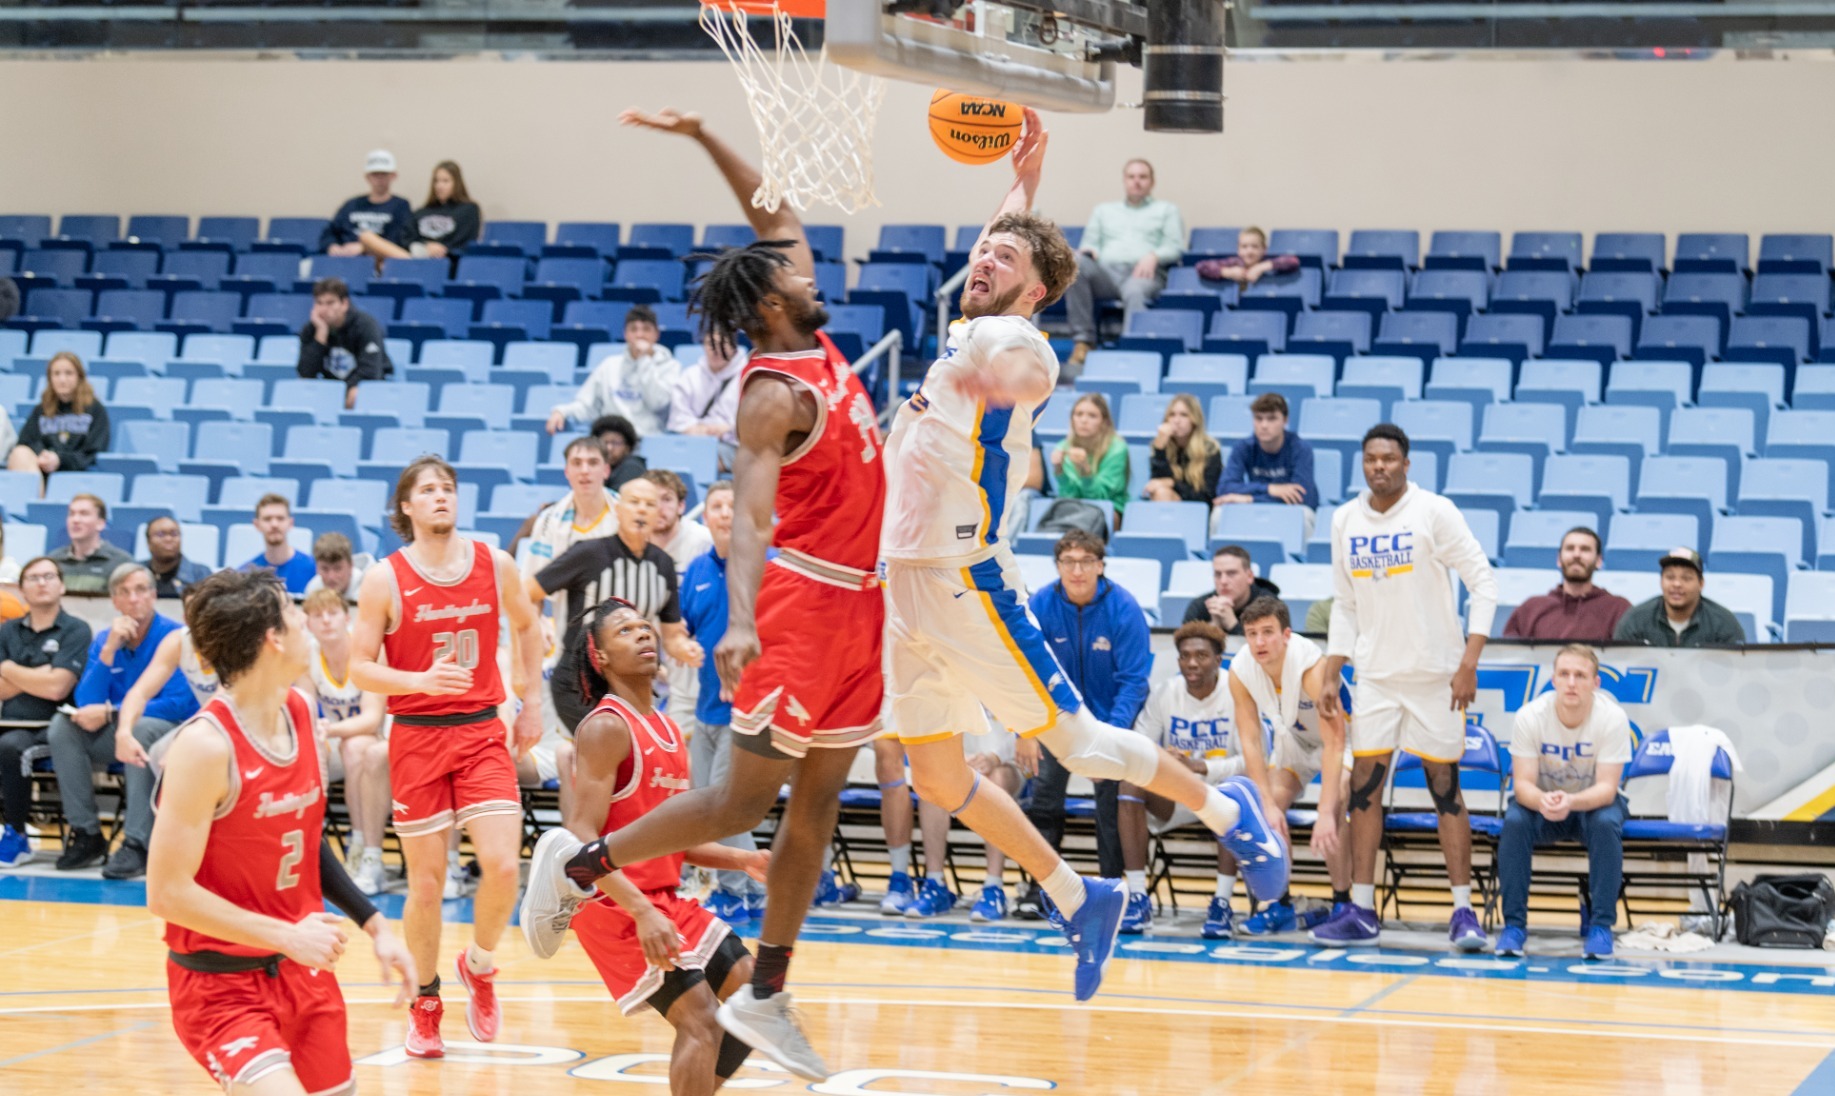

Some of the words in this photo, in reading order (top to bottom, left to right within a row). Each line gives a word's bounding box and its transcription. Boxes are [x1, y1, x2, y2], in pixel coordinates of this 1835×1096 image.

[960, 101, 1006, 119] NCAA
[950, 128, 1010, 150] Wilson
[1349, 532, 1413, 556] PCC
[1349, 551, 1413, 569] BASKETBALL
[431, 628, 480, 670] 20
[1170, 715, 1229, 738] PCC
[1169, 733, 1228, 751] BASKETBALL
[275, 828, 305, 892] 2
